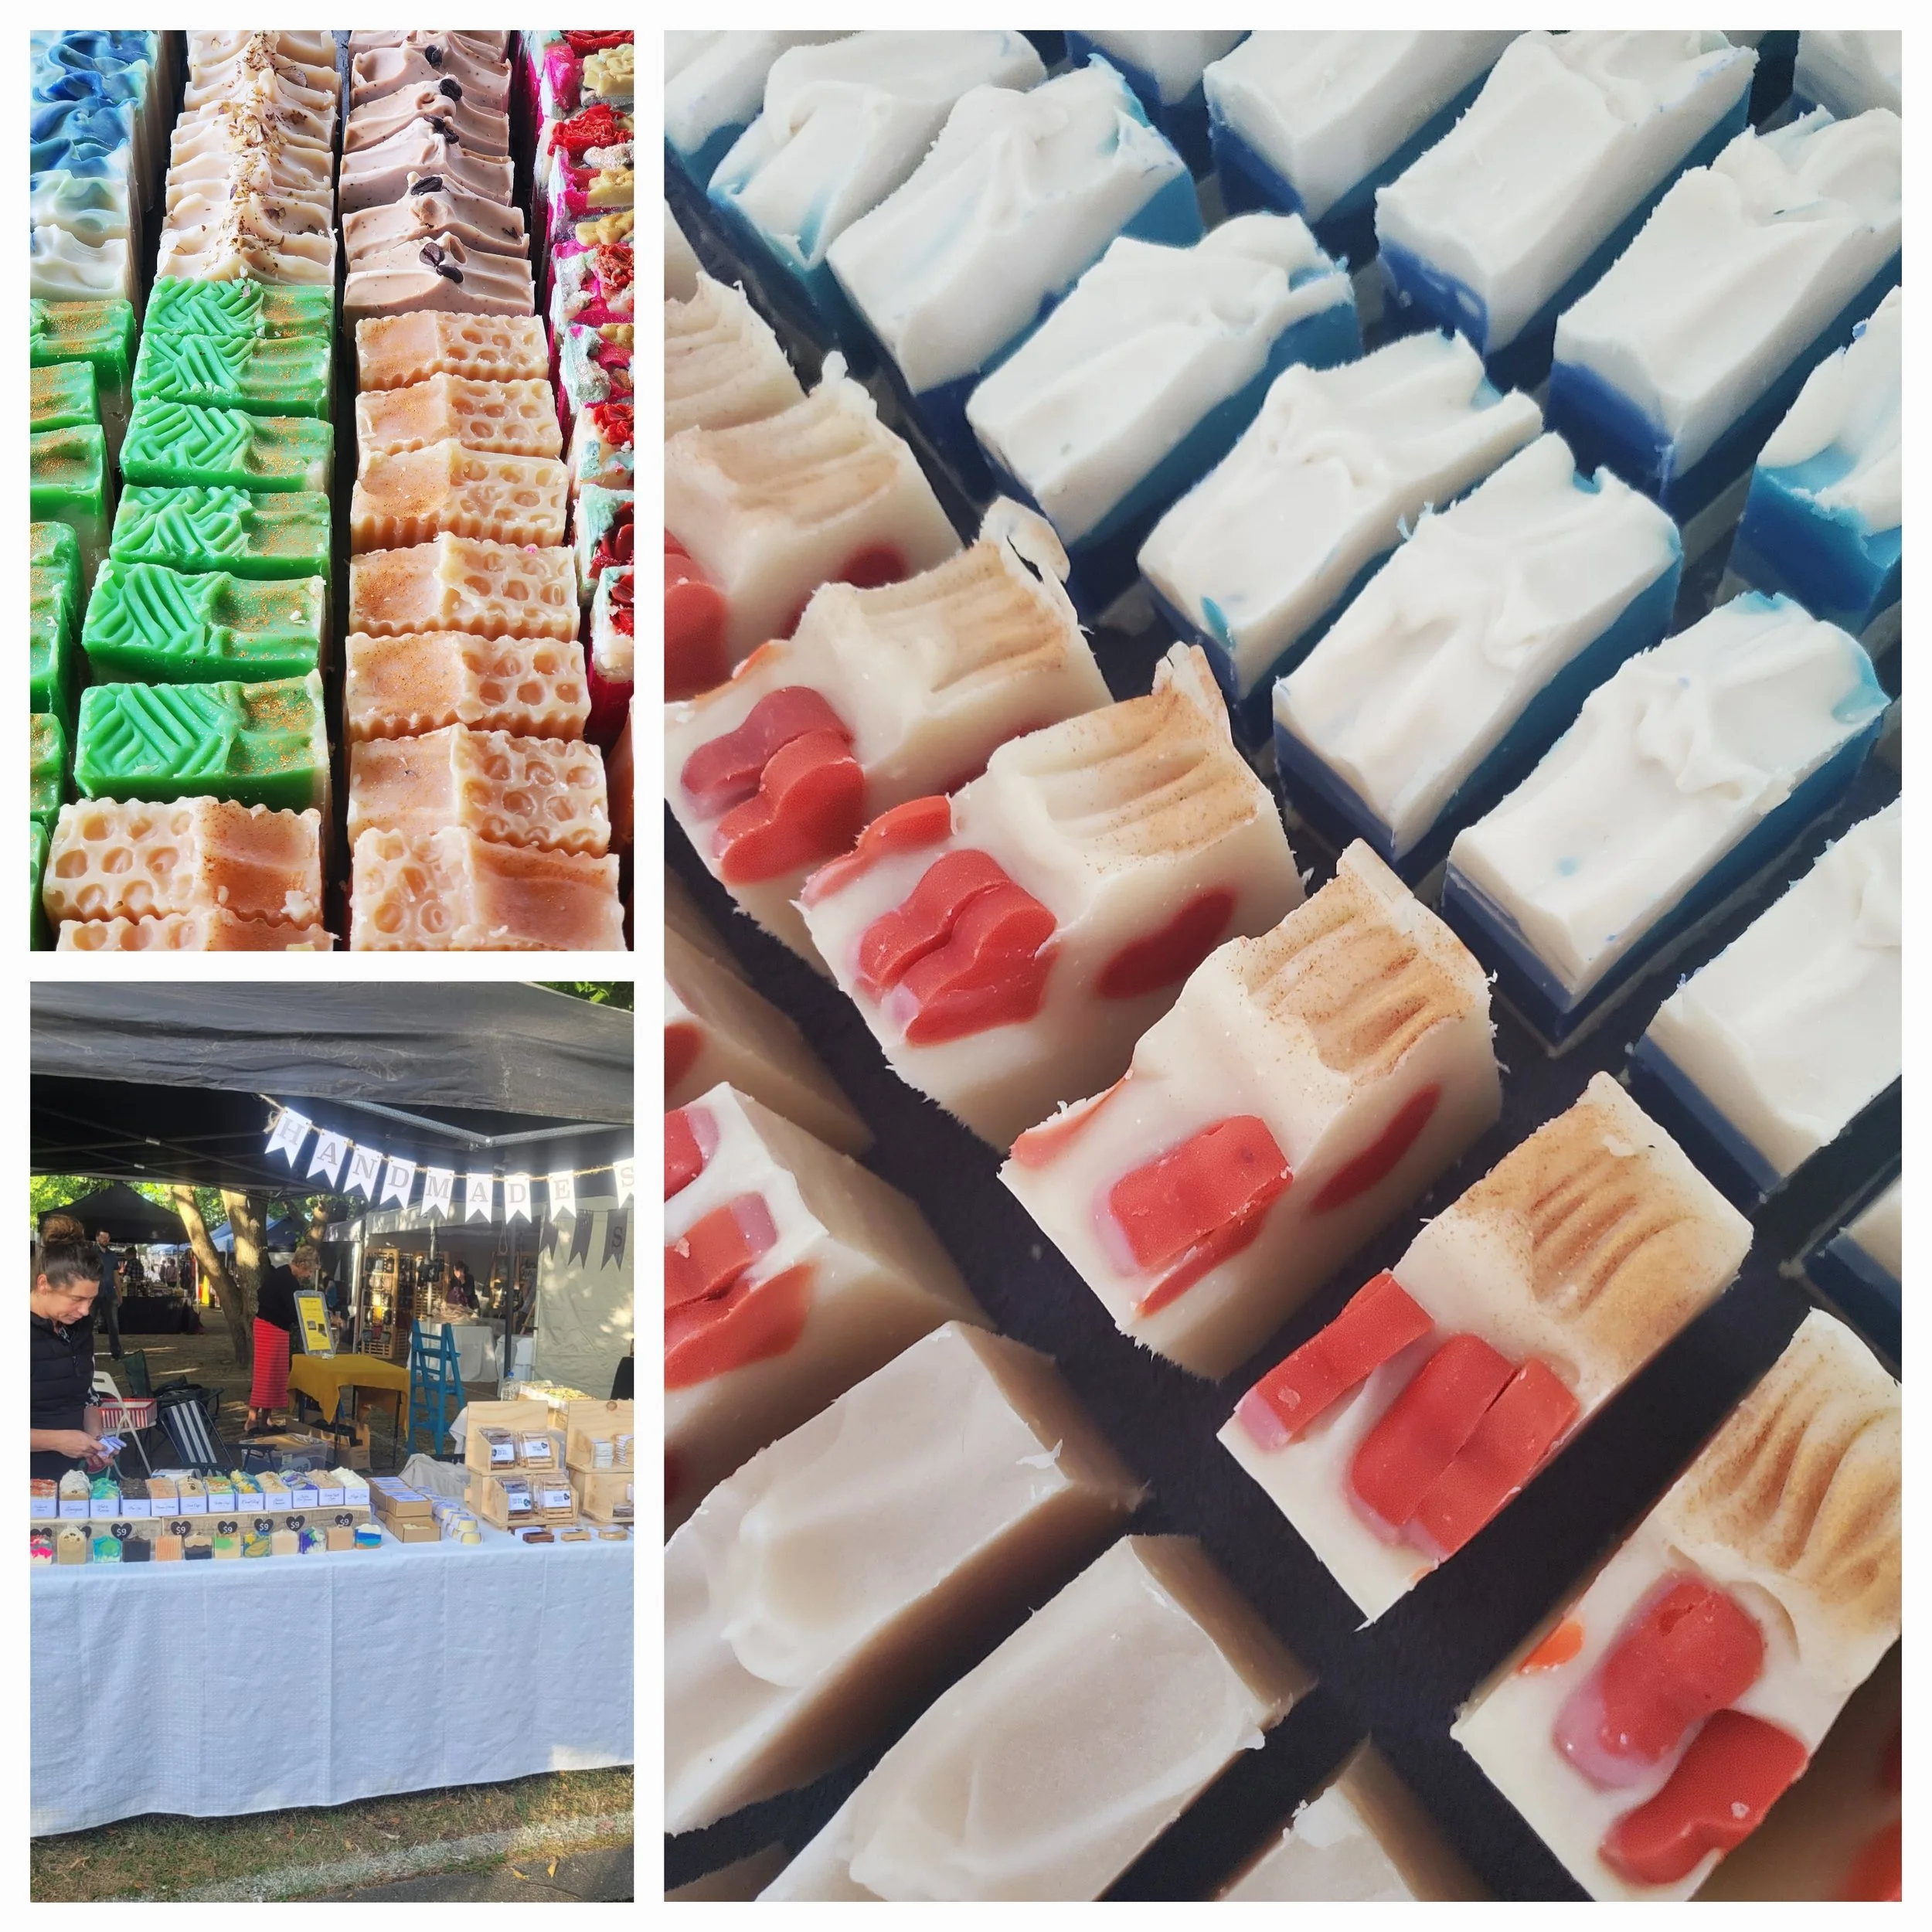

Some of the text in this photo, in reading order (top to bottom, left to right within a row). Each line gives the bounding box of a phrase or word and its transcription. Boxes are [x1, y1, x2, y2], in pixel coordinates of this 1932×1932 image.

[277, 1117, 570, 1203] HANDMADE
[259, 1522, 269, 1532] $9
[290, 1521, 301, 1529] $9
[116, 1528, 128, 1537] $9
[175, 1526, 186, 1535] $9
[223, 1526, 233, 1534] $9
